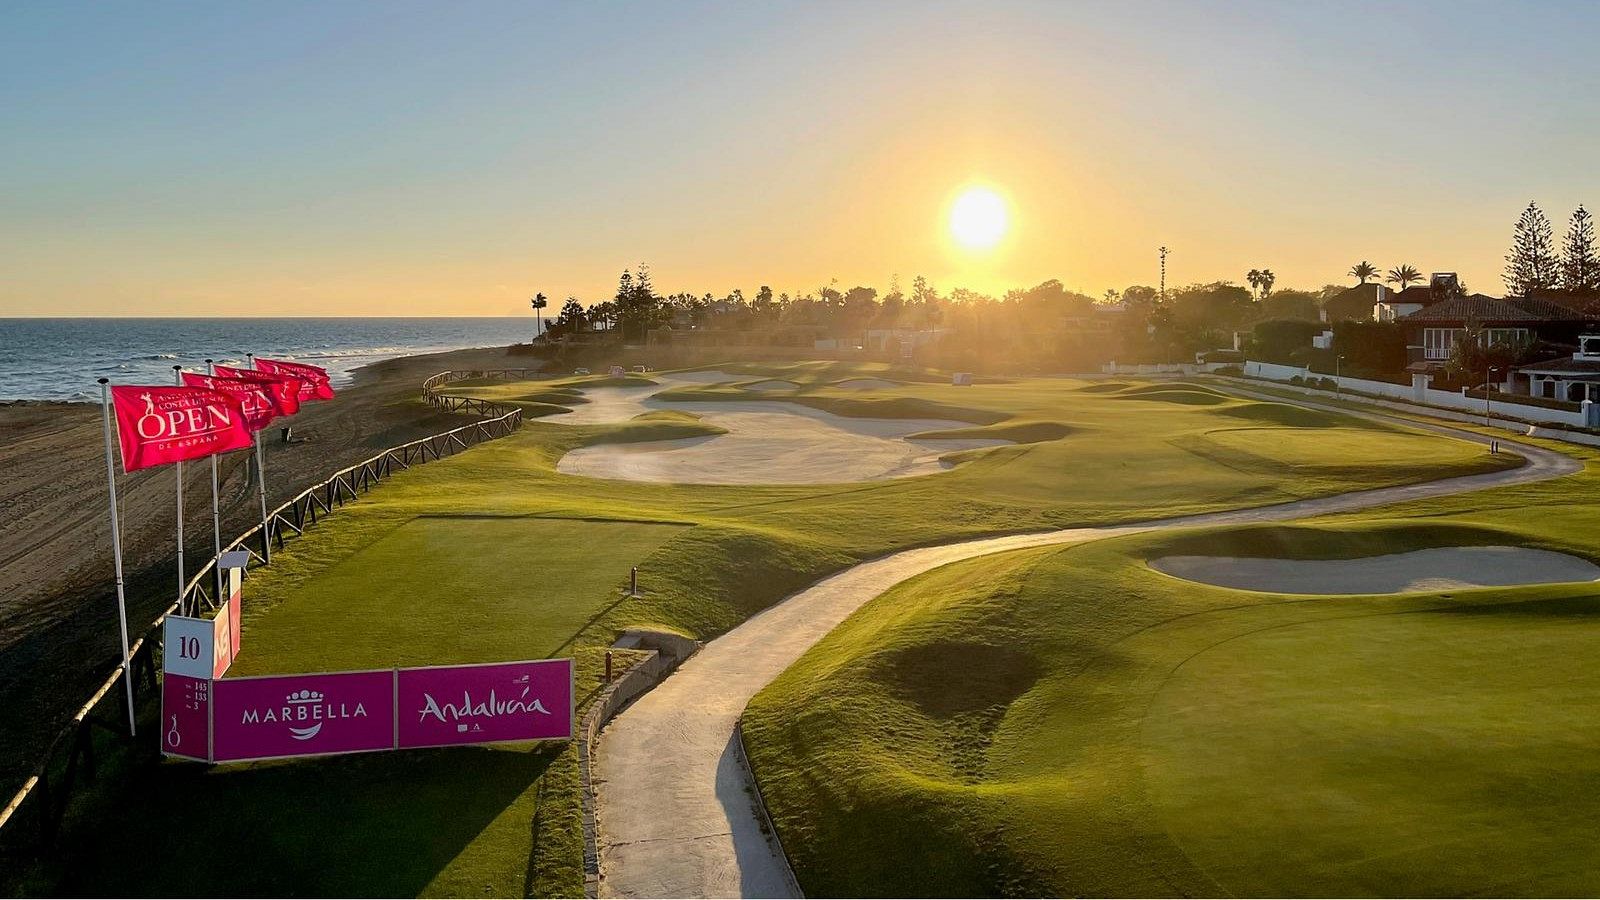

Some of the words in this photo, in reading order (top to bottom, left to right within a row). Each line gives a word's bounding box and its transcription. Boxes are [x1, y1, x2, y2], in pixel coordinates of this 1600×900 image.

[158, 399, 191, 410] COSTA
[137, 404, 231, 438] OPEN
[179, 636, 200, 660] 10
[193, 701, 199, 710] 3
[195, 692, 207, 701] 133
[418, 686, 551, 723] Andalucía
[242, 703, 367, 724] MARBELLA
